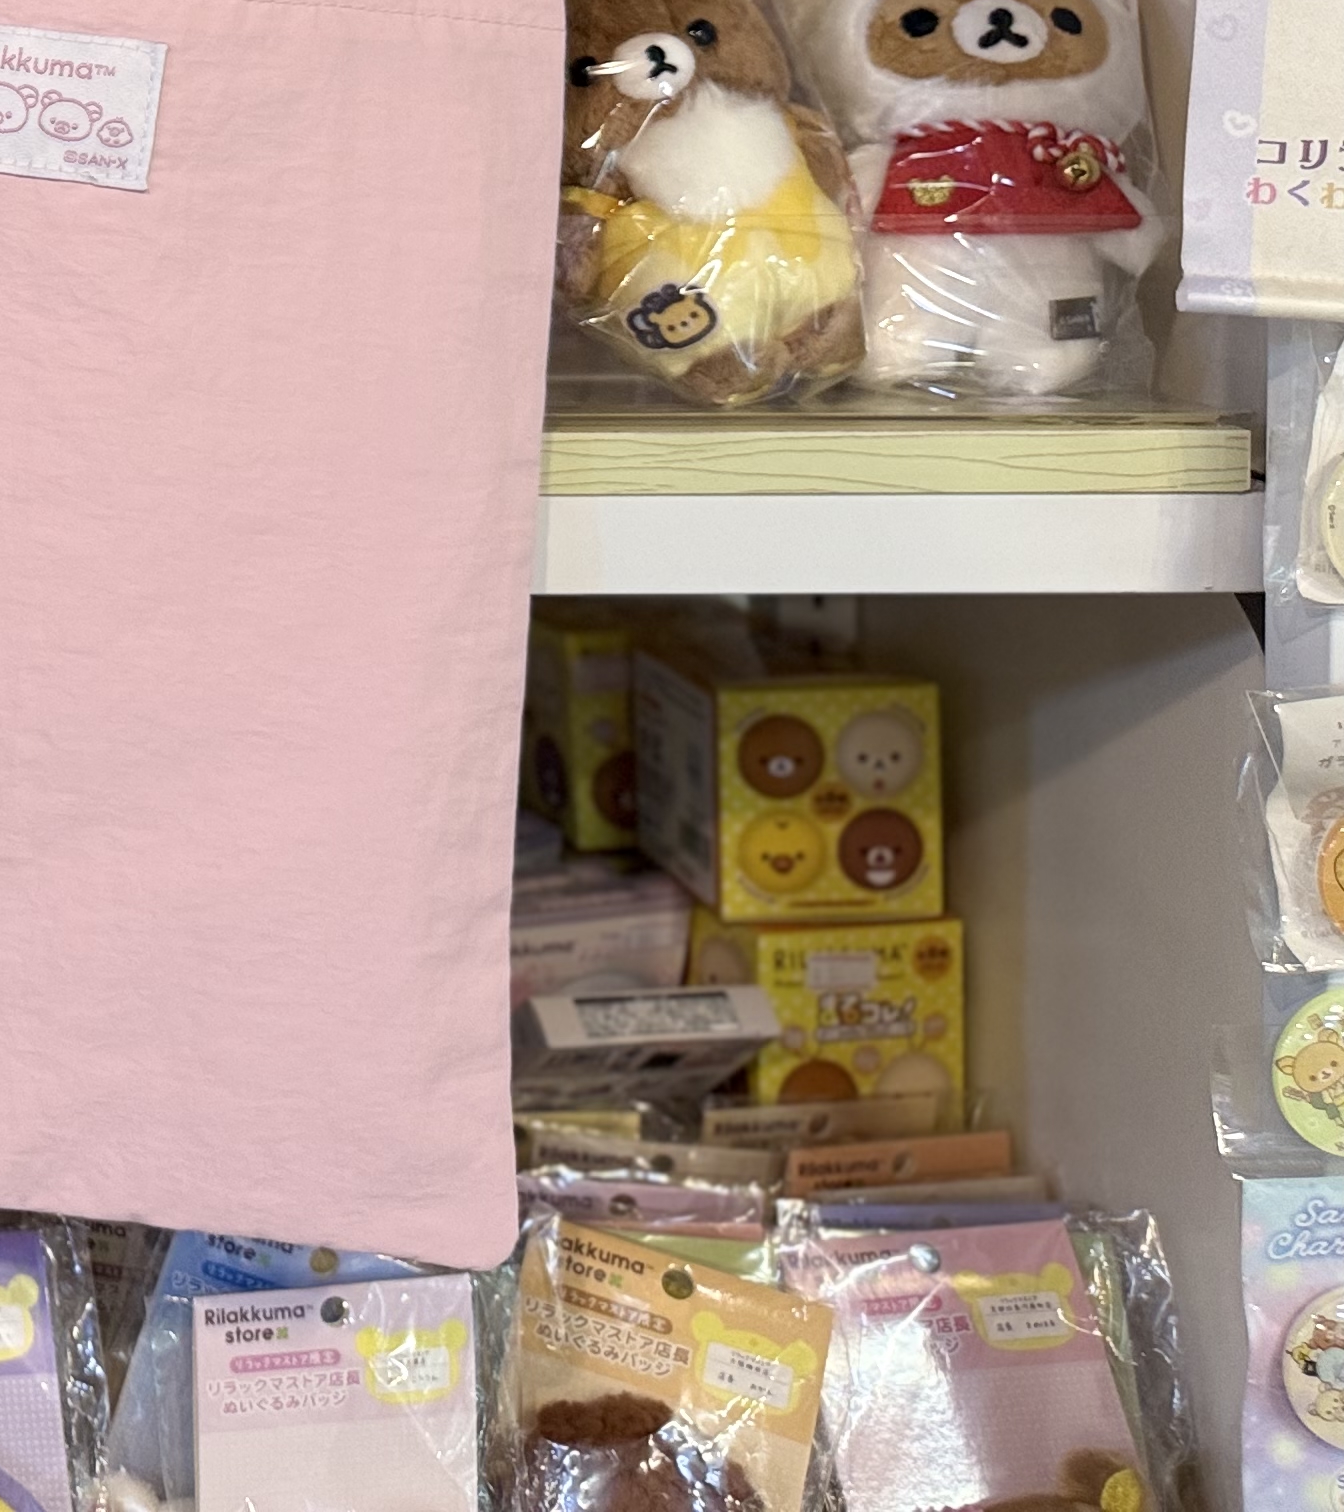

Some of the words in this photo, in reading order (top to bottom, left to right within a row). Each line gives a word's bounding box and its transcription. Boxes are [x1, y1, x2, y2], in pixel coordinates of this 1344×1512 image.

[1257, 139, 1344, 173] コリ
[225, 1326, 274, 1344] store
[223, 1391, 346, 1414] ぬいぐるみバッジ
